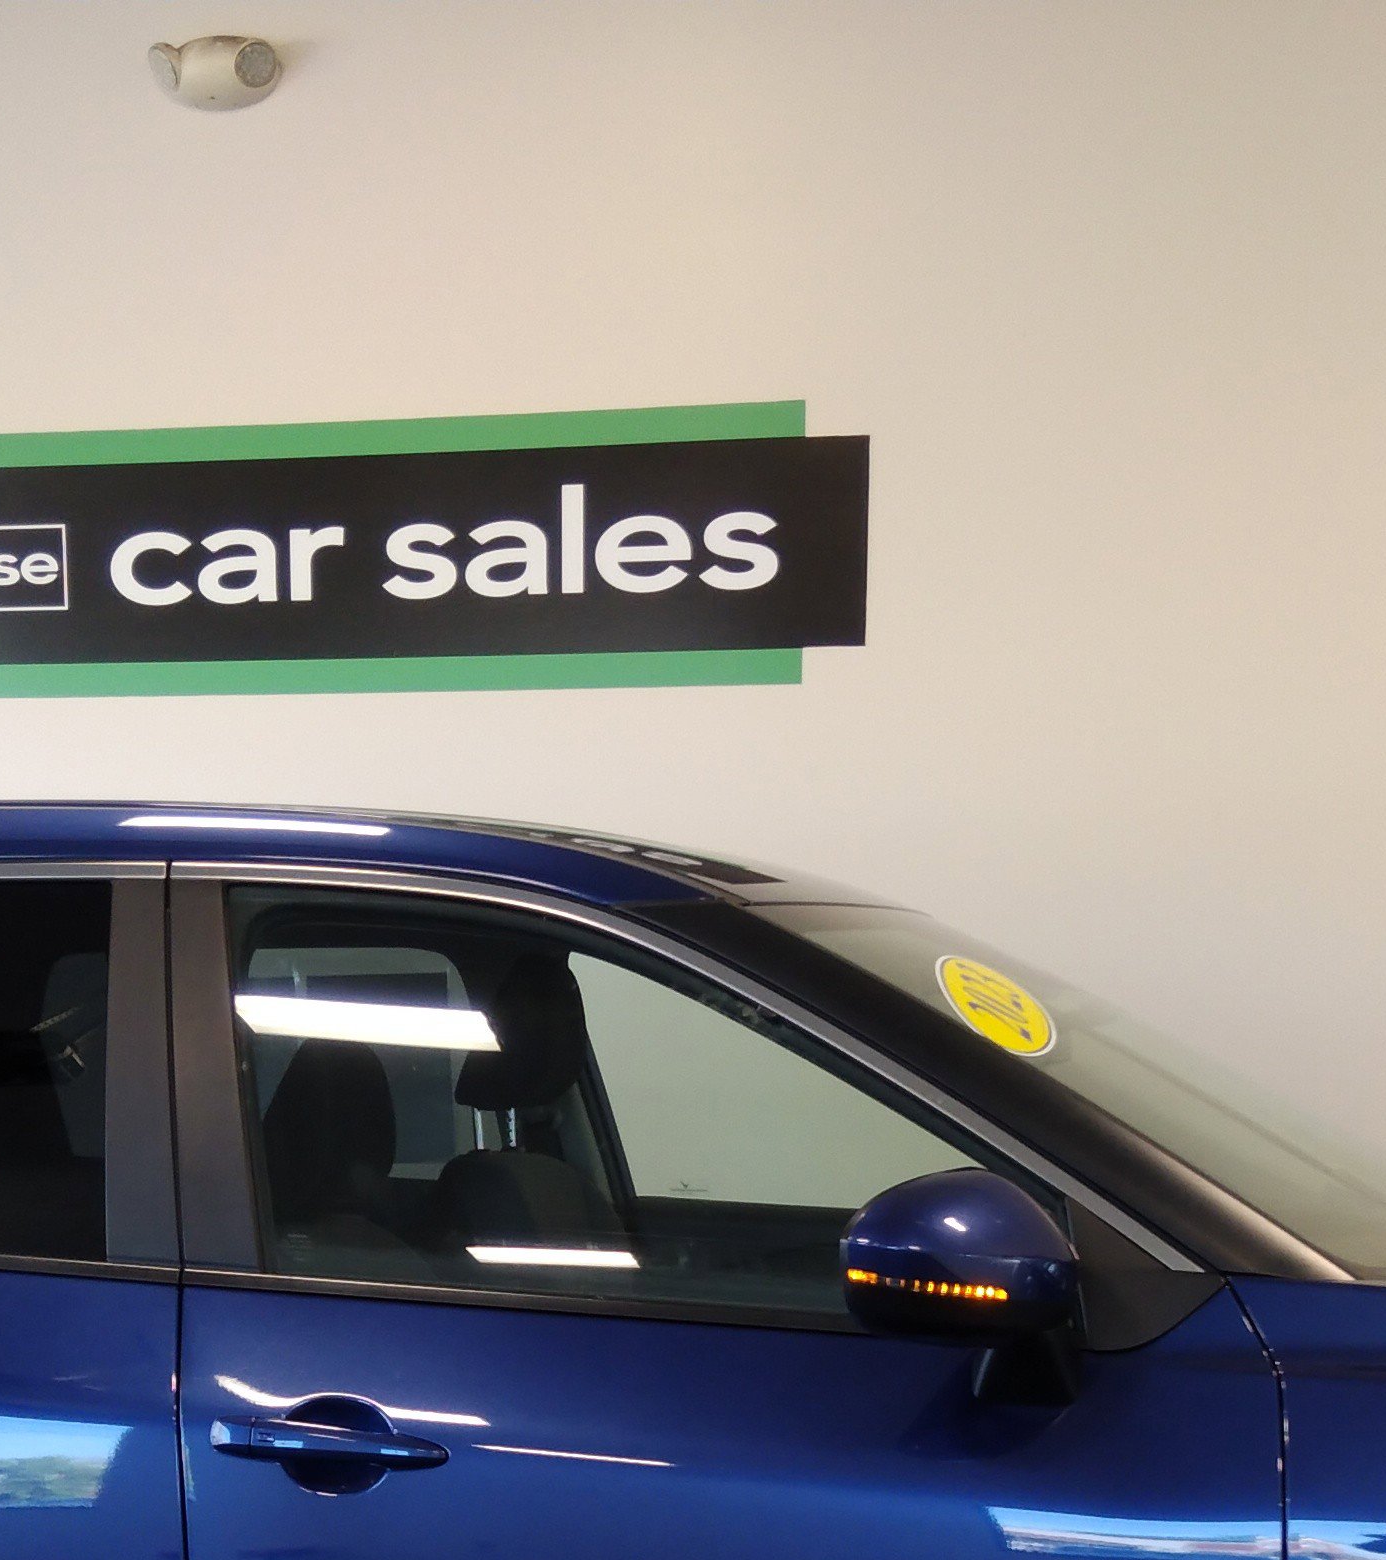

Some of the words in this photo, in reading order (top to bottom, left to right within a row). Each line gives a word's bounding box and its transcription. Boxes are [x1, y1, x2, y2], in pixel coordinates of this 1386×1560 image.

[109, 526, 345, 607] car
[381, 484, 779, 600] sales
[956, 961, 1033, 1043] 2023
